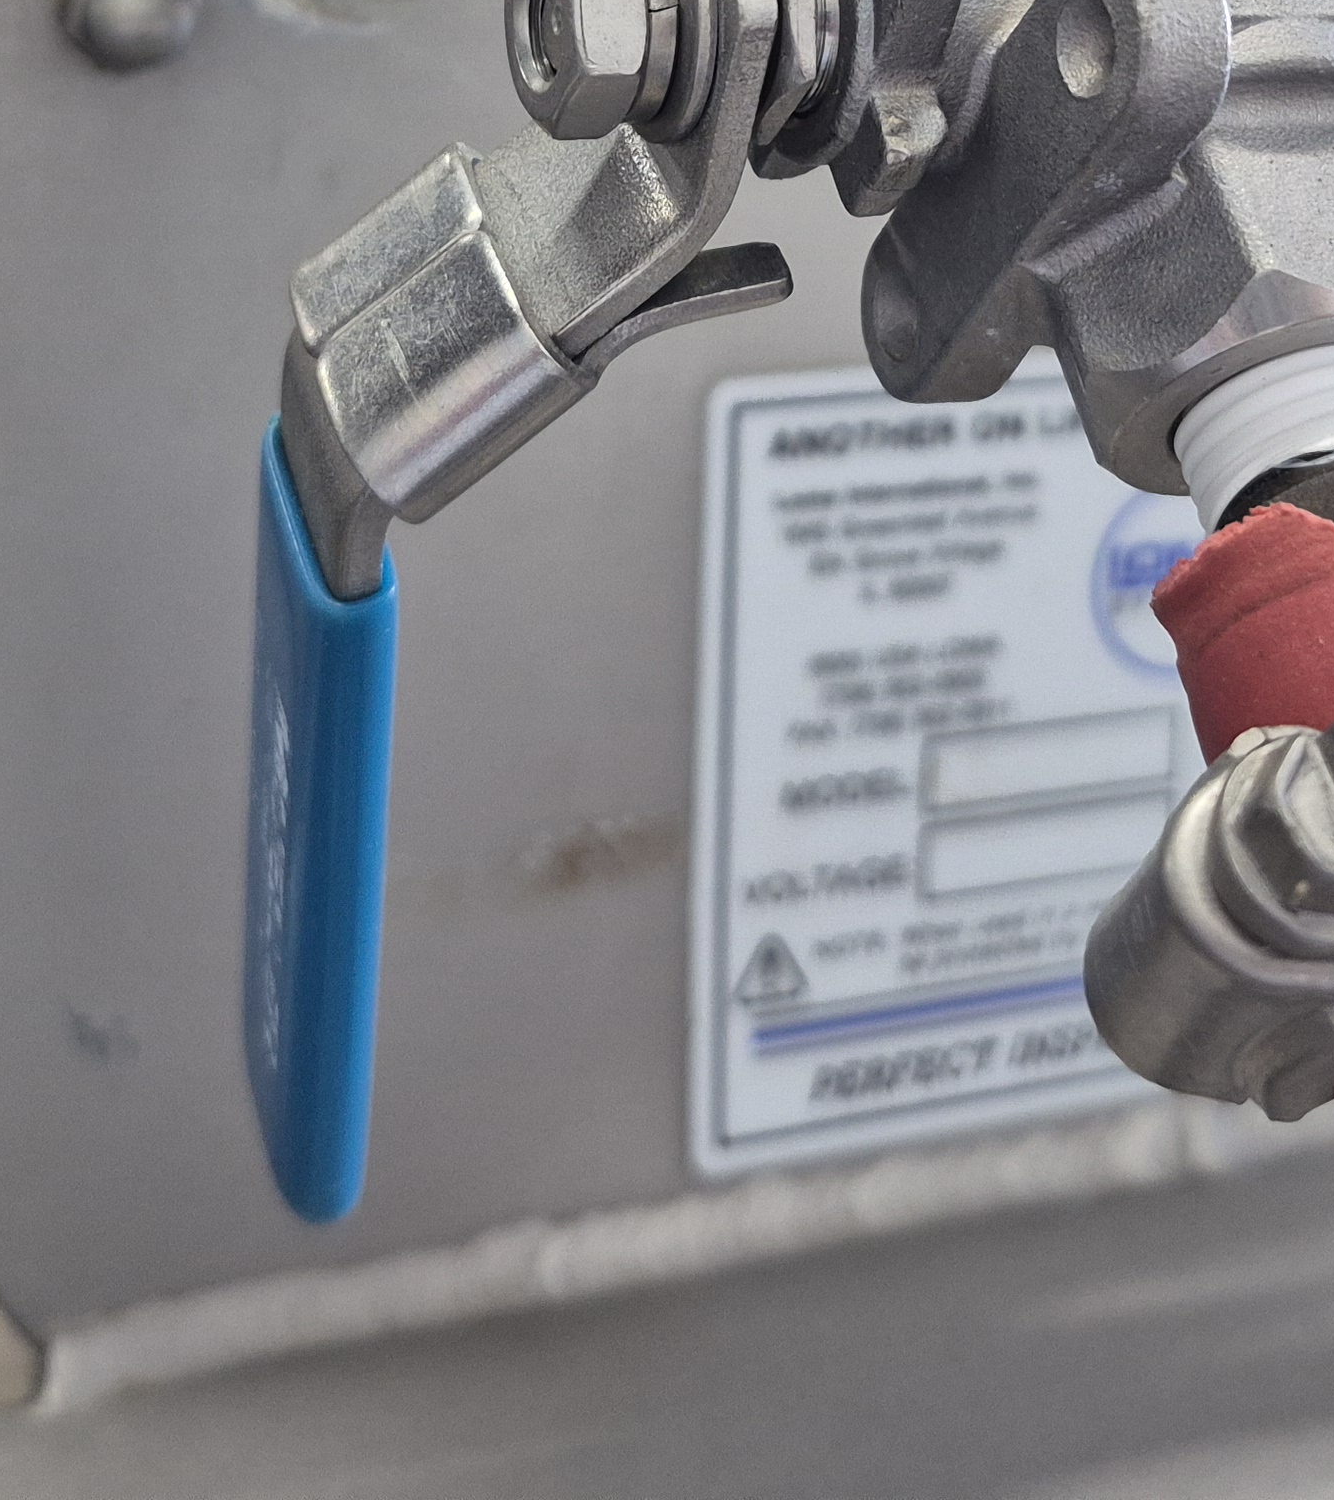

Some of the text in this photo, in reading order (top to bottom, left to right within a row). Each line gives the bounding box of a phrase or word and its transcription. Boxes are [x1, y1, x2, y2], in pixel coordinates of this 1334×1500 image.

[769, 414, 957, 460] ANOTHER
[972, 409, 1026, 442] ON
[747, 852, 910, 904] VOLTAGE
[809, 1035, 999, 1102] PERFECT
